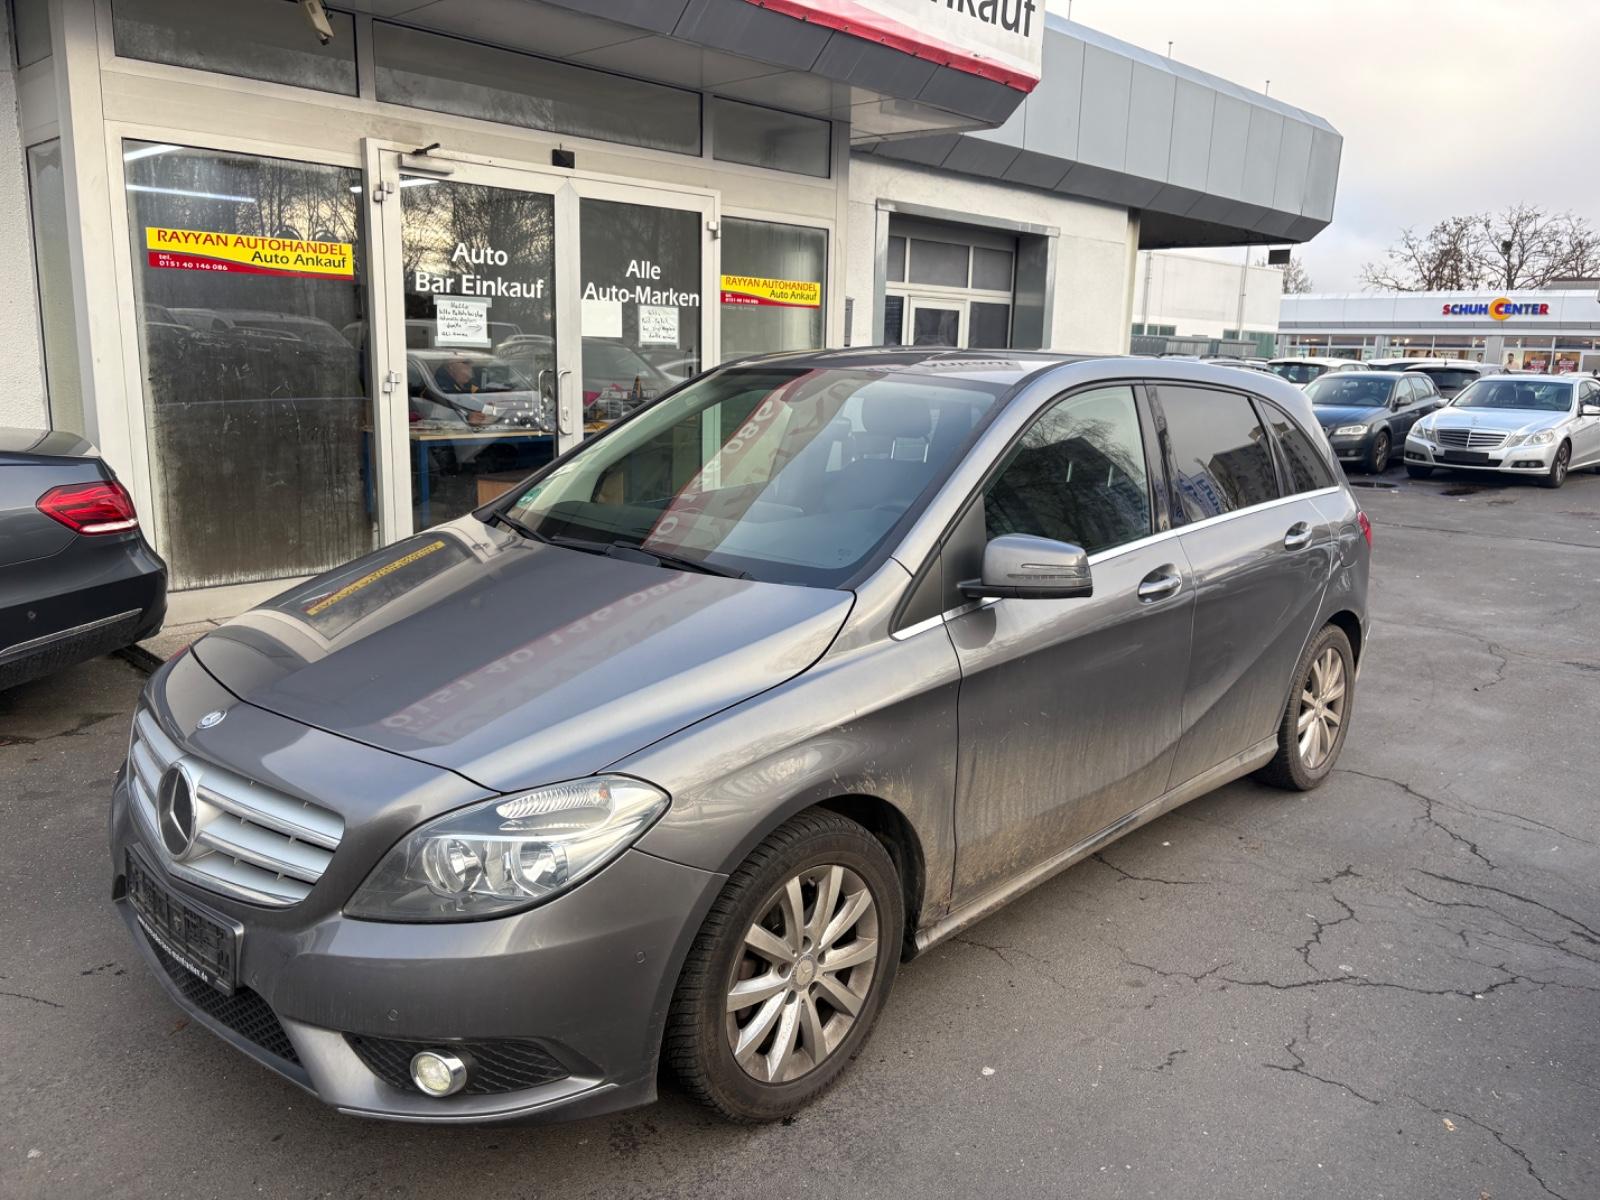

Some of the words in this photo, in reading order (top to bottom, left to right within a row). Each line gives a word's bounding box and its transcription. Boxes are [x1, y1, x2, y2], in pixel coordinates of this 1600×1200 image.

[157, 229, 228, 247] RAYYAN
[233, 235, 347, 256] AUTOHANDEL
[251, 251, 289, 264] Auto
[294, 253, 347, 269] Ankauf
[451, 242, 508, 266] Auto
[625, 259, 661, 280] Alle
[415, 271, 455, 293] Bar
[461, 274, 545, 299] Einkauf
[582, 282, 700, 307] Auto-Marken
[725, 276, 760, 288] RAYYAN
[762, 280, 817, 292] AUTOHANDEL
[769, 290, 788, 299] Auto
[790, 291, 817, 301] Ankauf
[1442, 304, 1489, 315] SCHUH
[1494, 303, 1549, 315] CENTER
